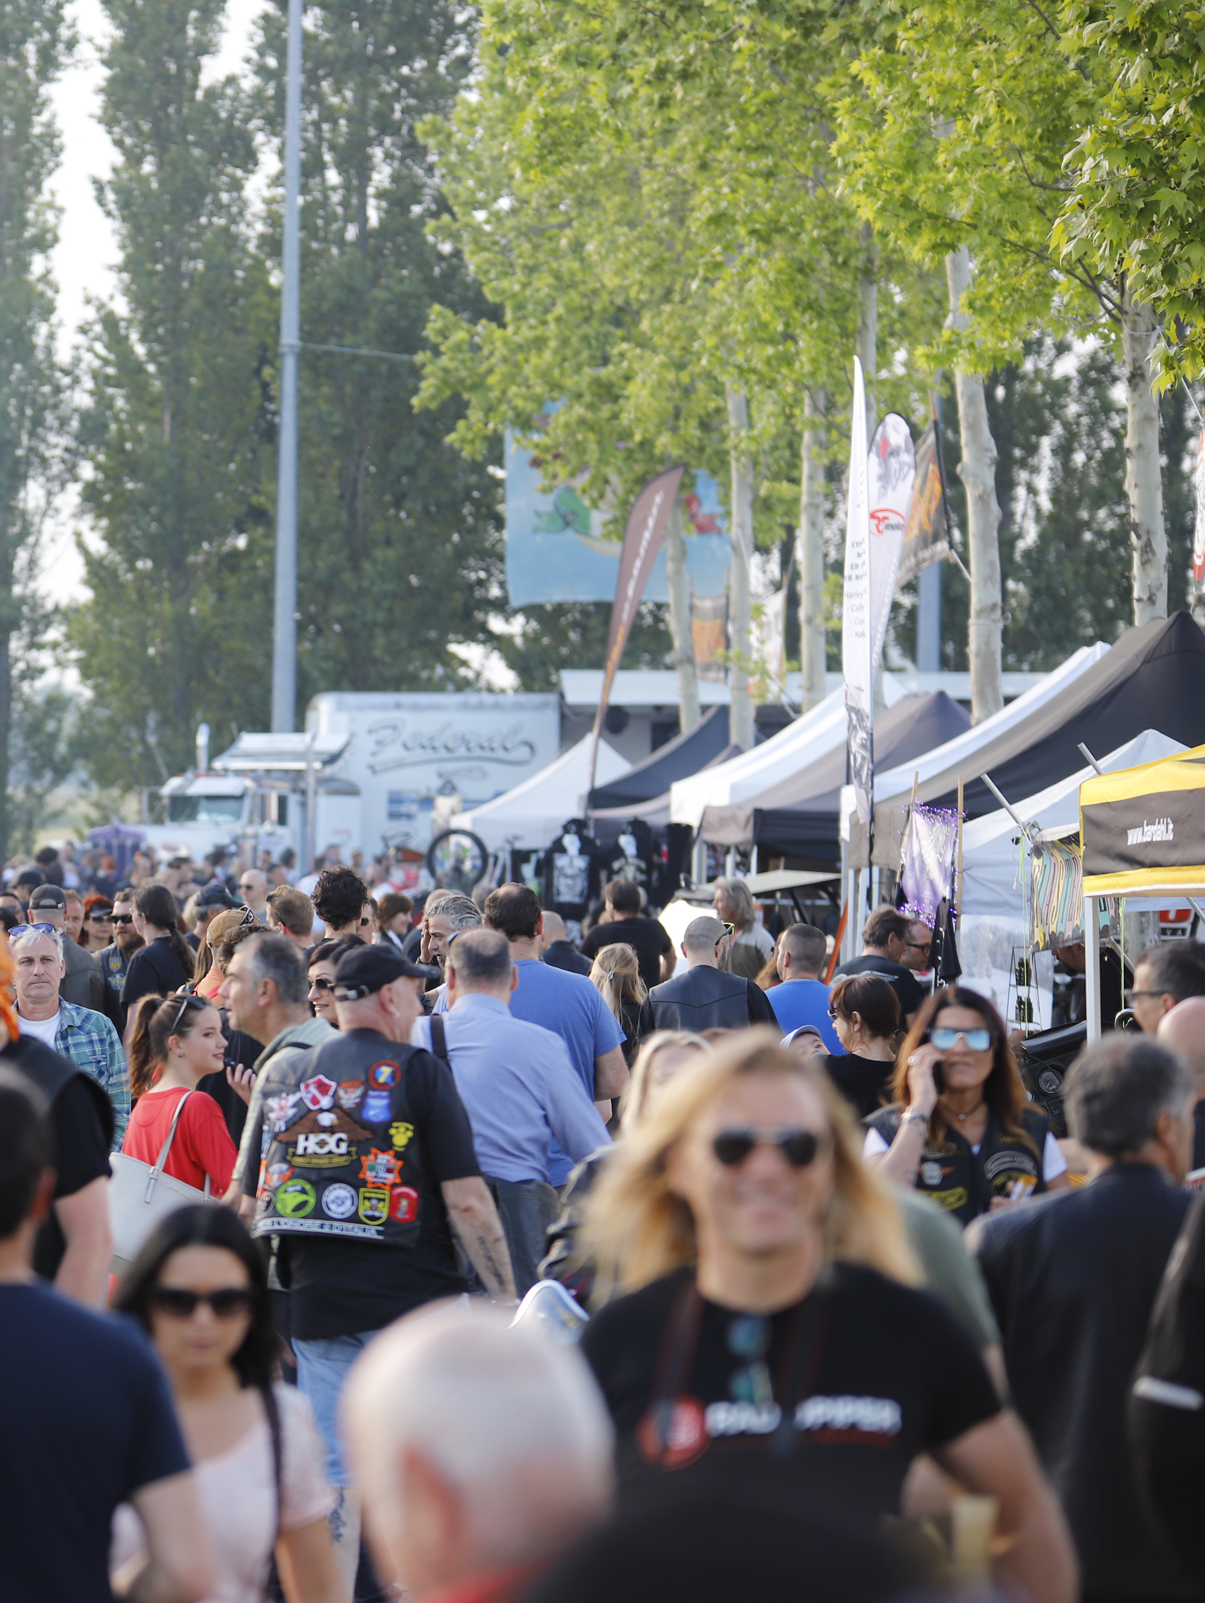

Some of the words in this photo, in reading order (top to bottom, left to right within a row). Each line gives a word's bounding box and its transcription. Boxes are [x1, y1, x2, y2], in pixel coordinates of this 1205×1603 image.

[367, 718, 526, 757] Federal
[1126, 817, 1175, 846] www.bardahl.it
[296, 1132, 350, 1155] HOG
